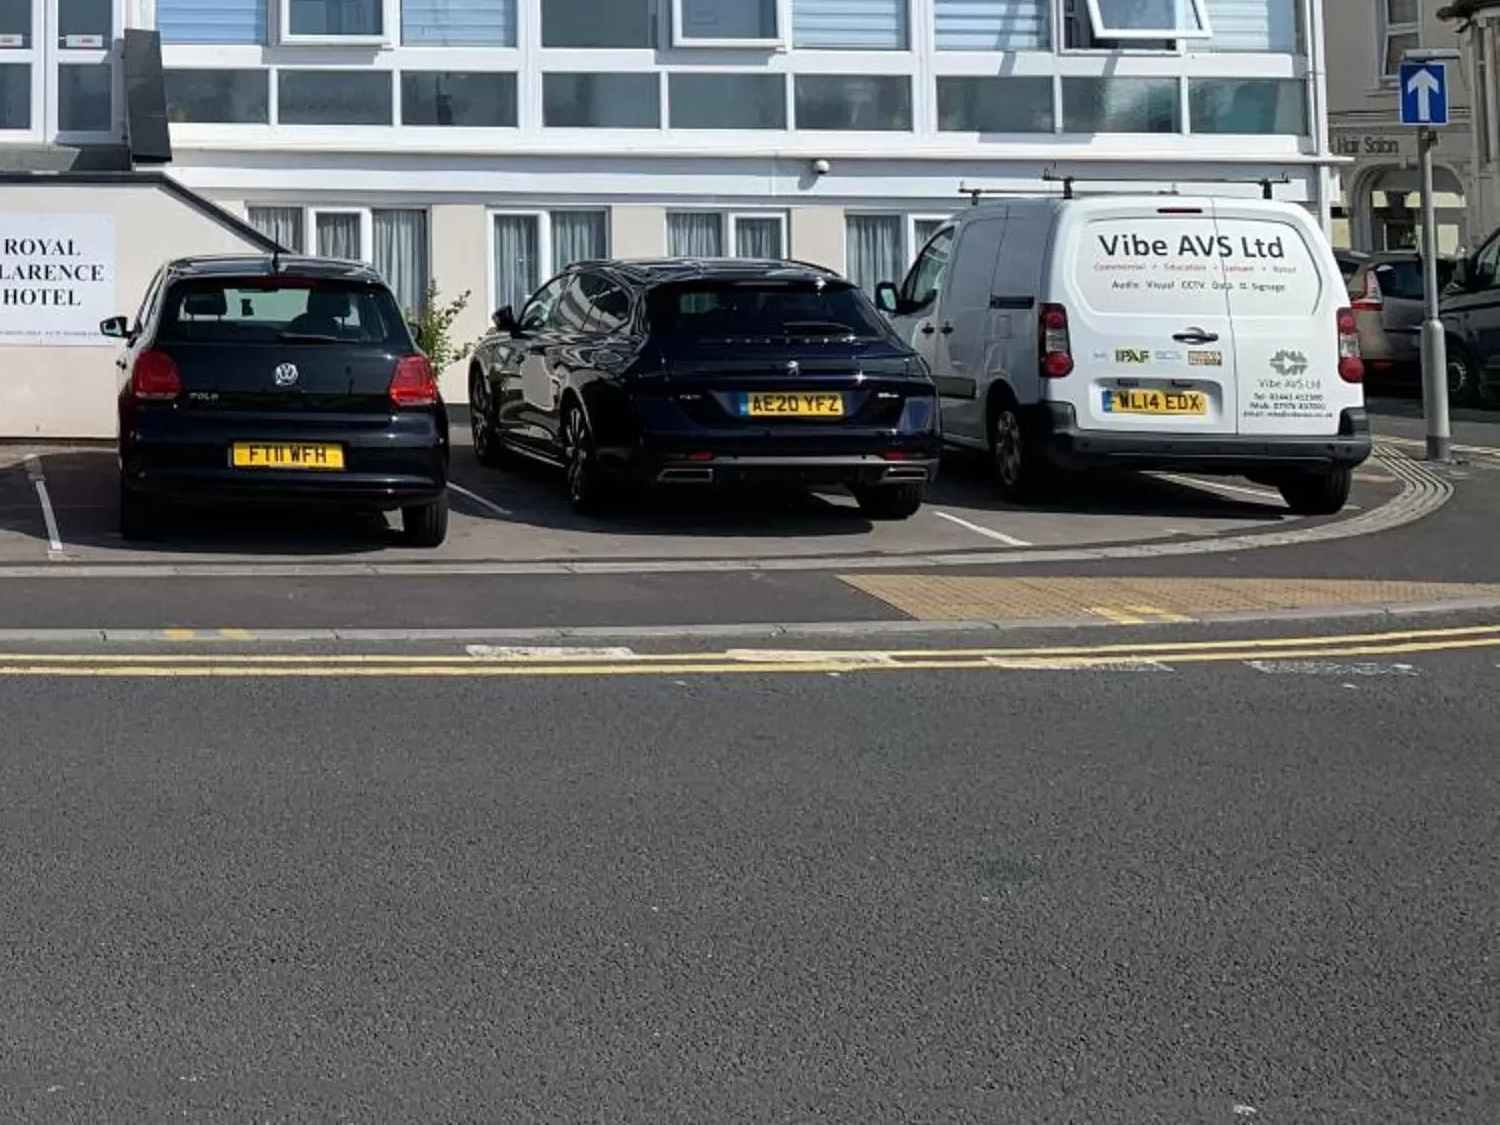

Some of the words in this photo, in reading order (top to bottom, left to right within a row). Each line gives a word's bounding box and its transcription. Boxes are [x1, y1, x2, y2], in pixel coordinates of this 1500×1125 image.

[1338, 136, 1360, 153] Hair
[1364, 136, 1399, 153] Salon
[4, 239, 81, 256] ROYAL
[1098, 234, 1168, 256] Vibe
[1178, 235, 1232, 257] AVS
[1241, 236, 1284, 258] Ltd
[3, 288, 81, 306] HOTEL
[1114, 349, 1150, 363] IPAF
[752, 395, 799, 412] AE20
[804, 395, 839, 412] YFZ
[1118, 391, 1160, 410] WL14
[1165, 392, 1201, 410] EDX
[249, 445, 284, 463] FT11
[290, 445, 327, 463] WFH
